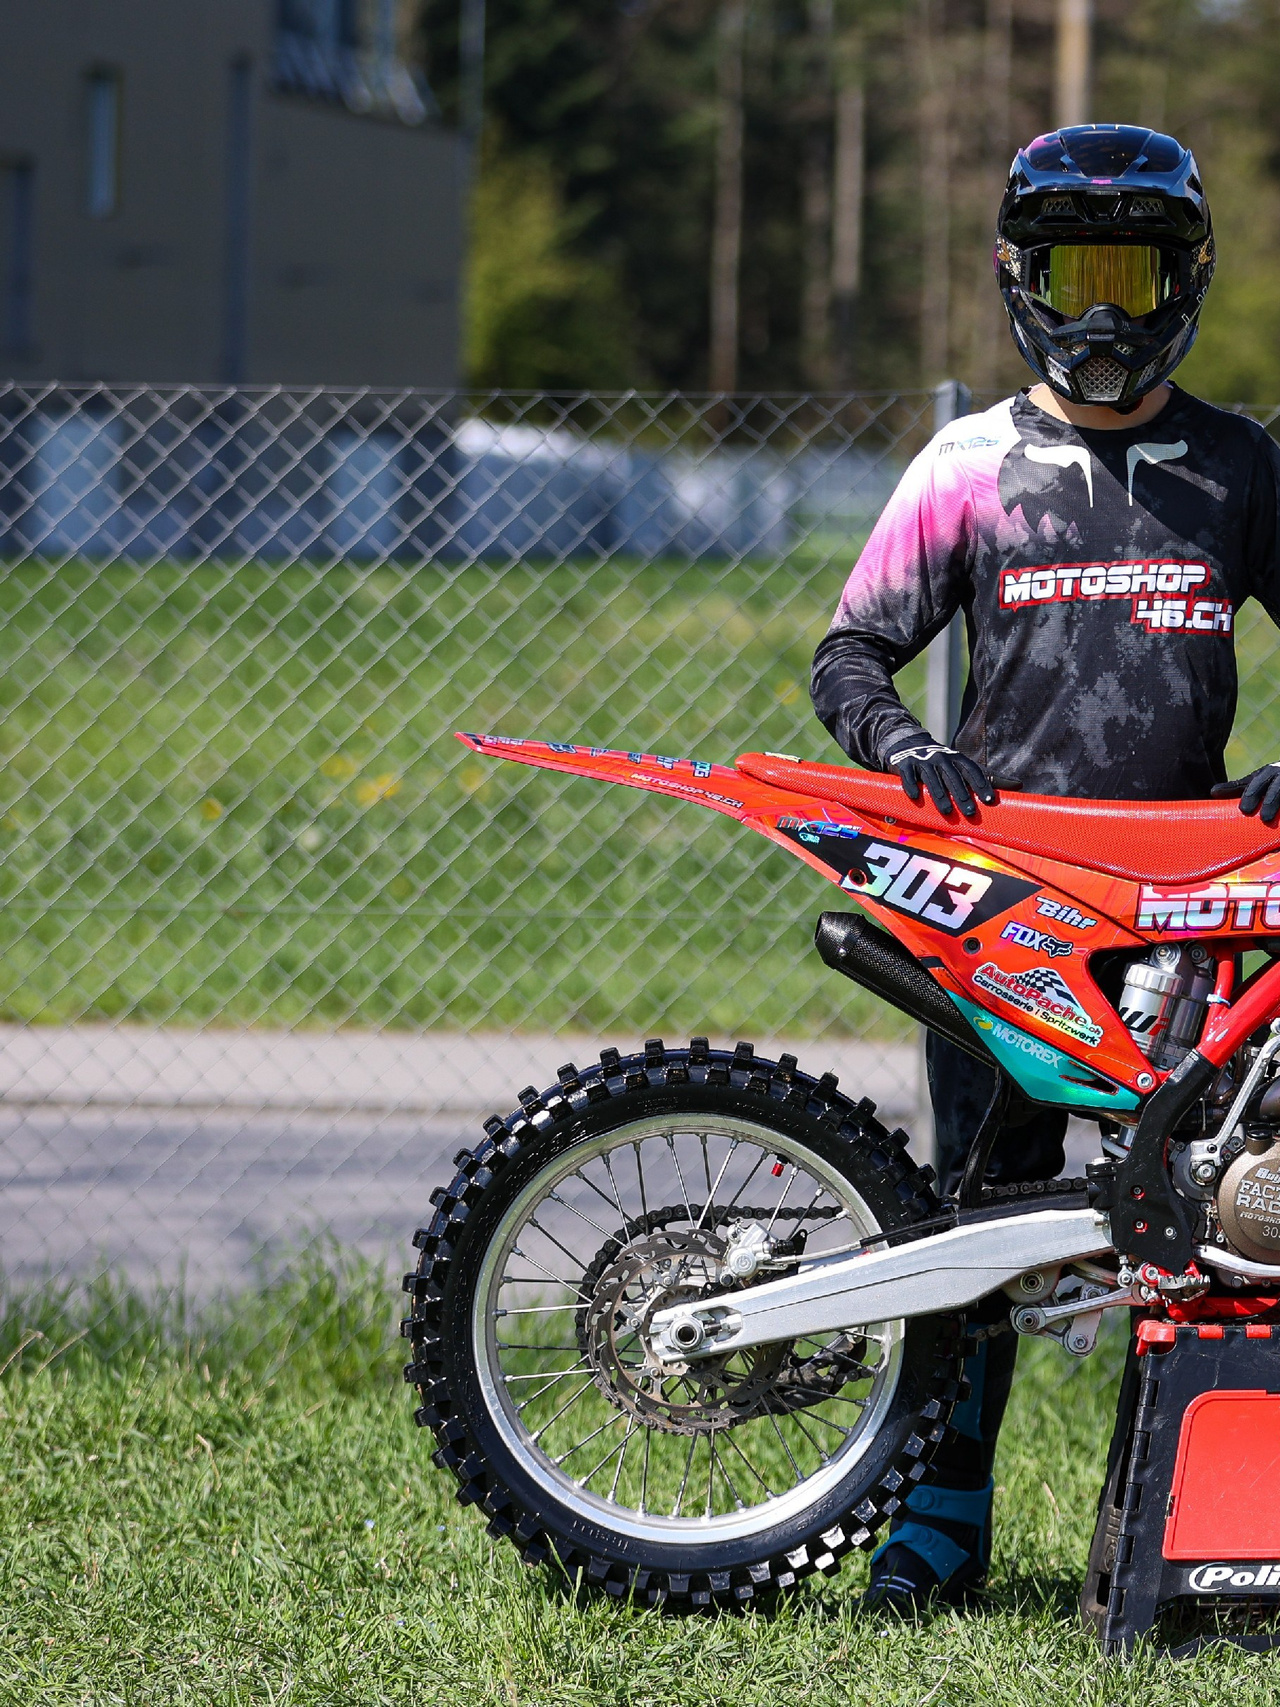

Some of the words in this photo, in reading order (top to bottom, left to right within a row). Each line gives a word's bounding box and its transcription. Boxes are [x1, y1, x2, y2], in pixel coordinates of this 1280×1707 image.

[1004, 564, 1206, 604] MOTOSHOP
[1136, 600, 1233, 632] 46.CH
[841, 842, 993, 929] 303
[1036, 896, 1097, 929] Bihr
[1000, 921, 1048, 951] FOX
[974, 974, 1034, 1012] Carrosserie
[1040, 1011, 1098, 1045] Spritzwerk
[992, 1022, 1063, 1068] MOTOREX
